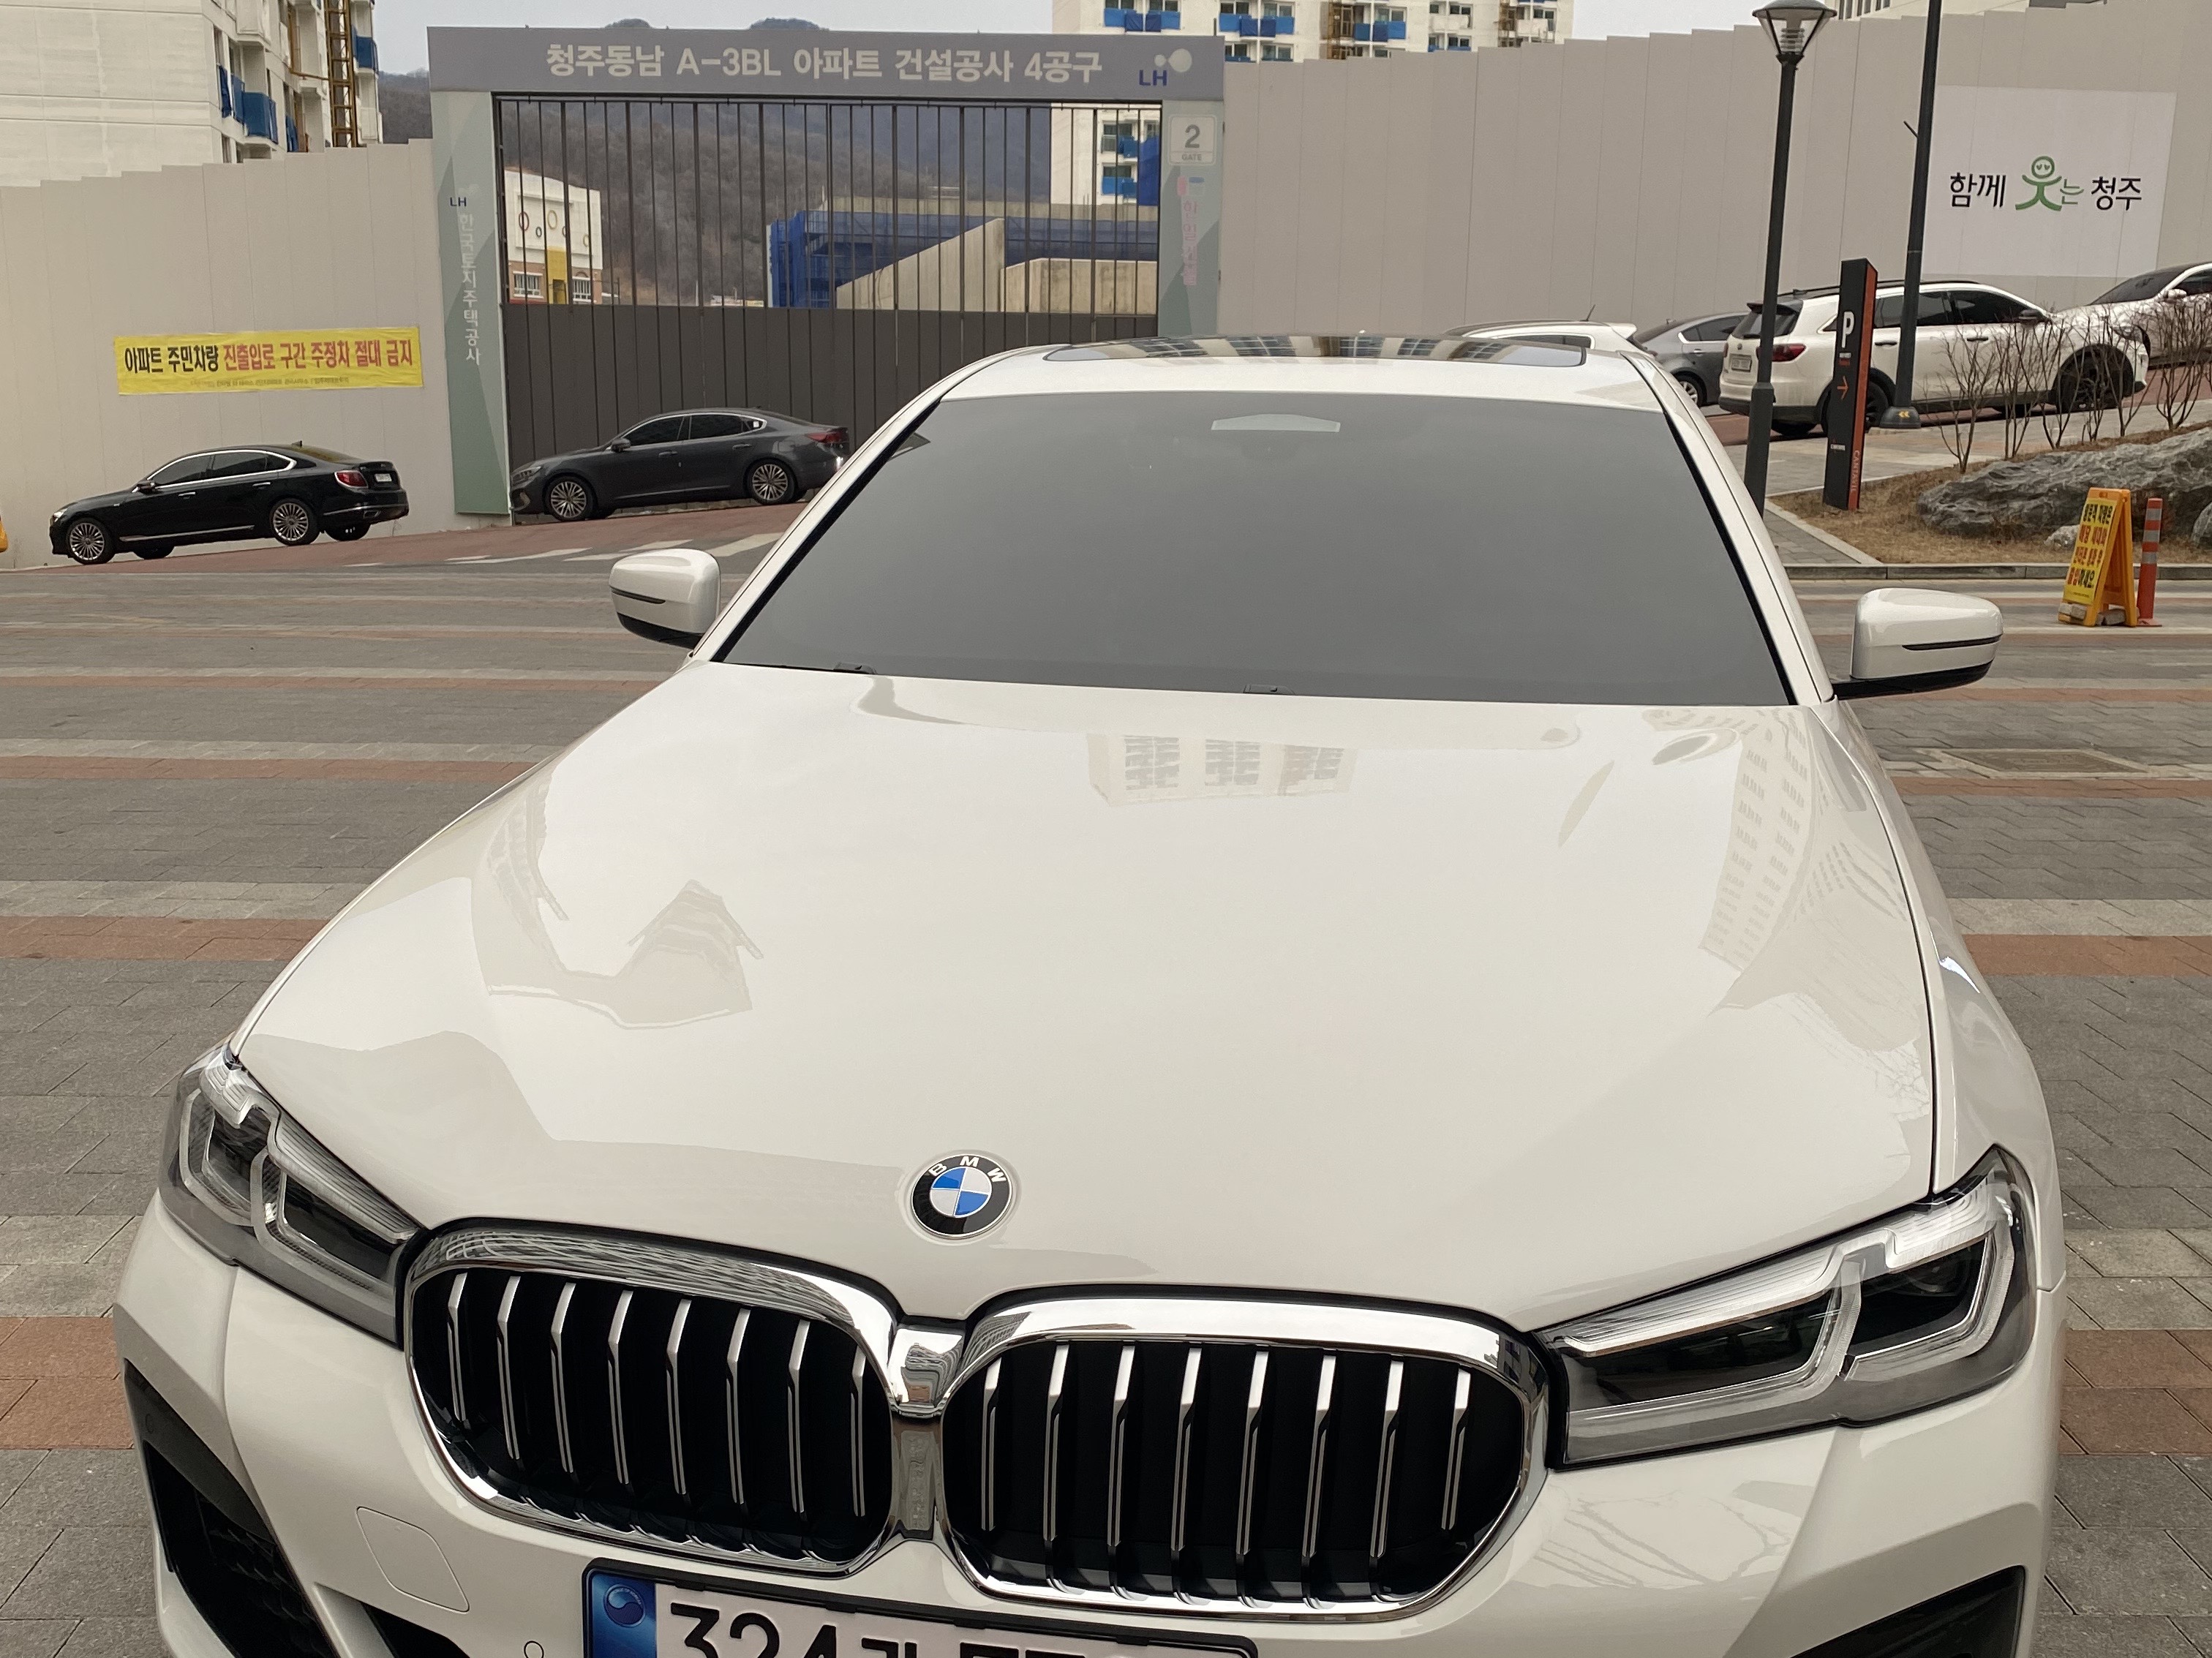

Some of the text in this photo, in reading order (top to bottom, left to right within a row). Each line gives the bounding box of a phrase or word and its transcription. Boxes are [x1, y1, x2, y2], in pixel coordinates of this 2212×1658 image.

[546, 44, 1103, 83] 청주동남 A-3BL 아파트 건설공사 4공구
[1139, 69, 1167, 87] LH
[1184, 124, 1200, 148] 2
[1181, 153, 1202, 162] GATE
[1950, 155, 2143, 211] 함께 웃는 청주
[449, 196, 467, 207] LH
[459, 212, 481, 366] 한국토지주택공사
[1841, 311, 1855, 349] P
[124, 339, 413, 374] 아파트 주민차량 진출입로 구간 주정차 절대 금지
[928, 1156, 1007, 1183] BMW
